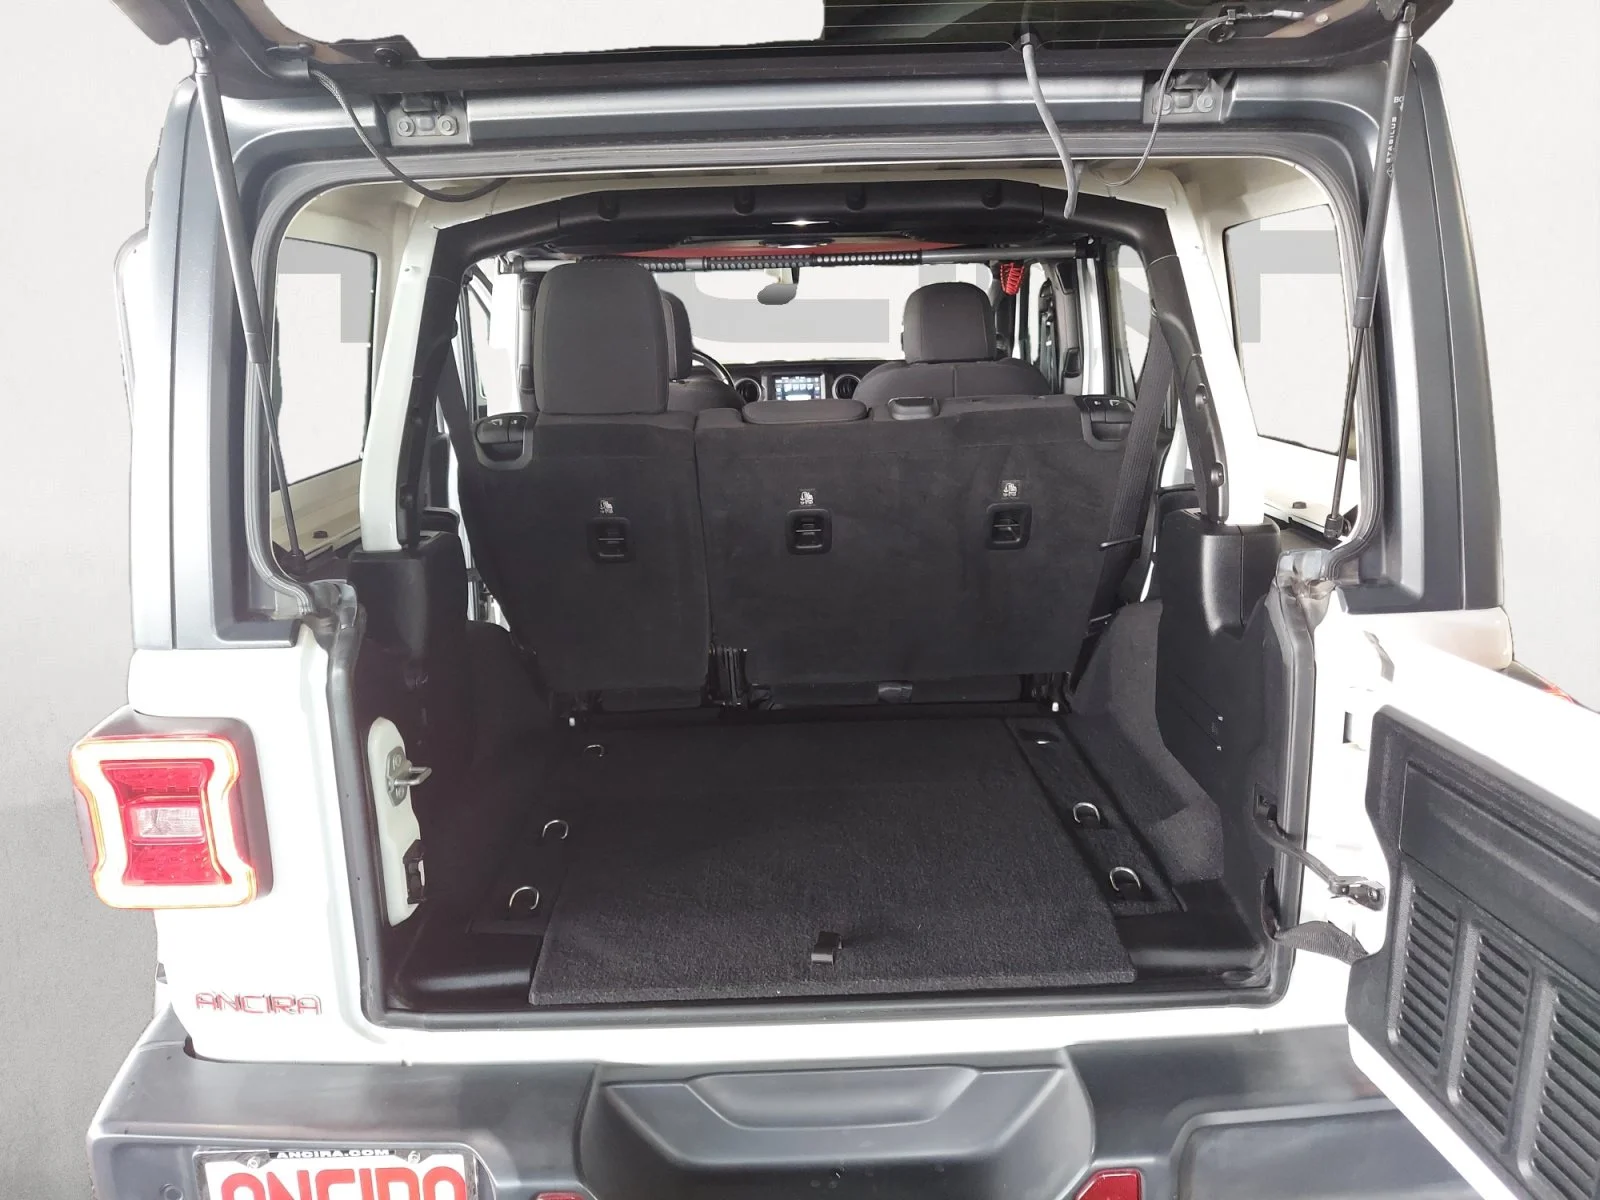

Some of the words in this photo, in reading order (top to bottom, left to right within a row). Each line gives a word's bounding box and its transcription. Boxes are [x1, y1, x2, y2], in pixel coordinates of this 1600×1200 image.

[1386, 116, 1397, 164] STABILUS
[195, 991, 322, 1015] ANCIRA
[277, 1149, 390, 1159] ANCIRA.COM
